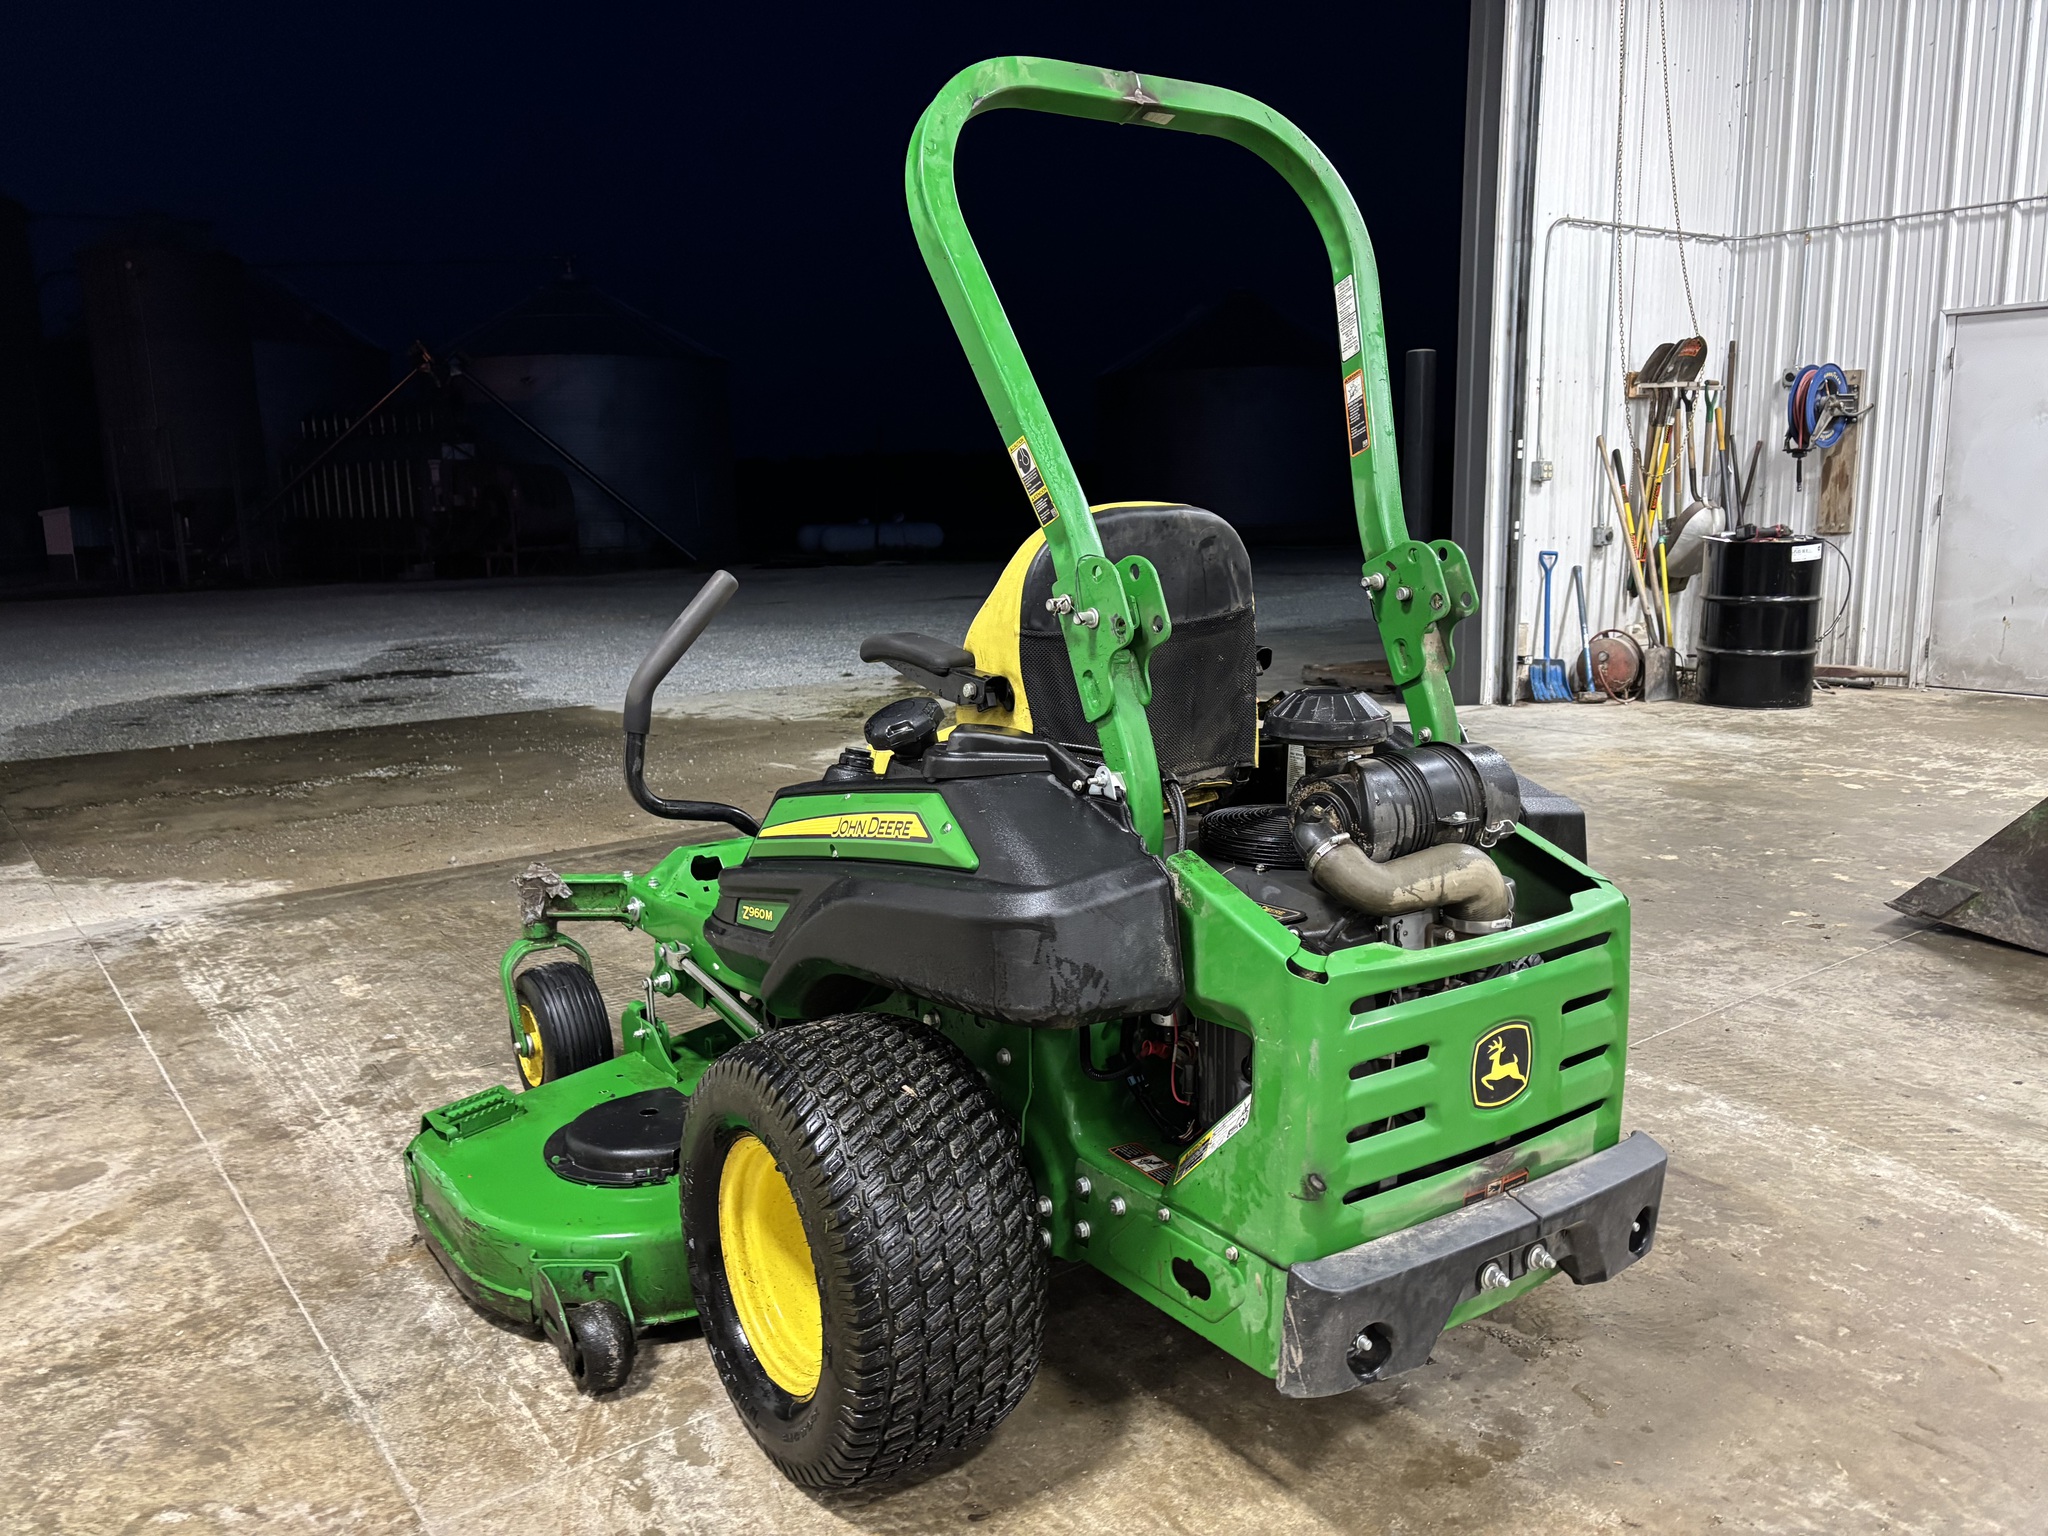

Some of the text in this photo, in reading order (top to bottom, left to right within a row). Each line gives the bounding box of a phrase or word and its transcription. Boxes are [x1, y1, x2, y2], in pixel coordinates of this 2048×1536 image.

[832, 816, 914, 836] JOHN DEERE
[742, 905, 773, 921] Z960M
